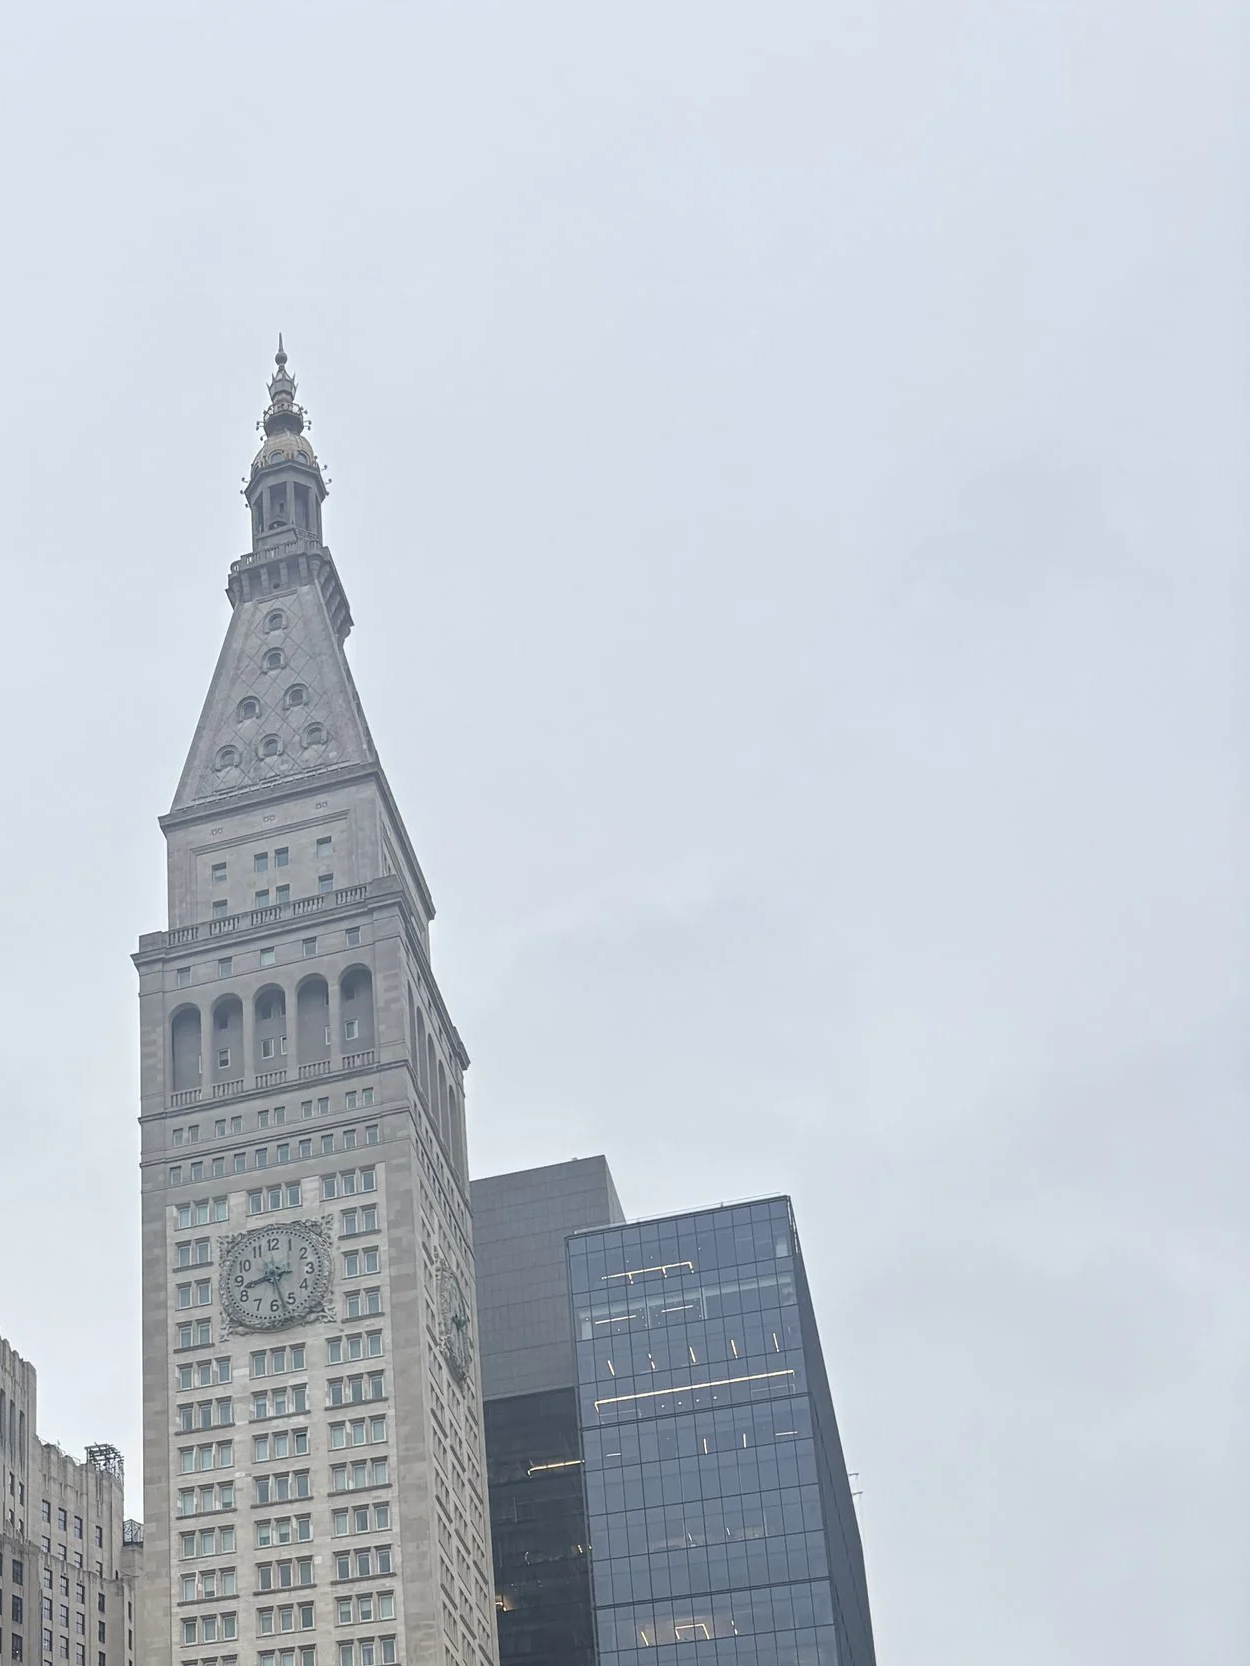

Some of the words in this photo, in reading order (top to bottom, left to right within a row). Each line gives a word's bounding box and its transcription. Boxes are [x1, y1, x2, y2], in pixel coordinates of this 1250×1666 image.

[267, 1238, 280, 1251] 12
[253, 1245, 262, 1259] 11
[299, 1247, 307, 1260] 2
[239, 1260, 251, 1273] 10
[305, 1262, 315, 1274] 3
[235, 1275, 244, 1287] 9
[299, 1278, 308, 1290] 4
[240, 1290, 249, 1302] 8
[286, 1292, 296, 1305] 5
[253, 1298, 262, 1311] 7
[270, 1299, 279, 1312] 6
